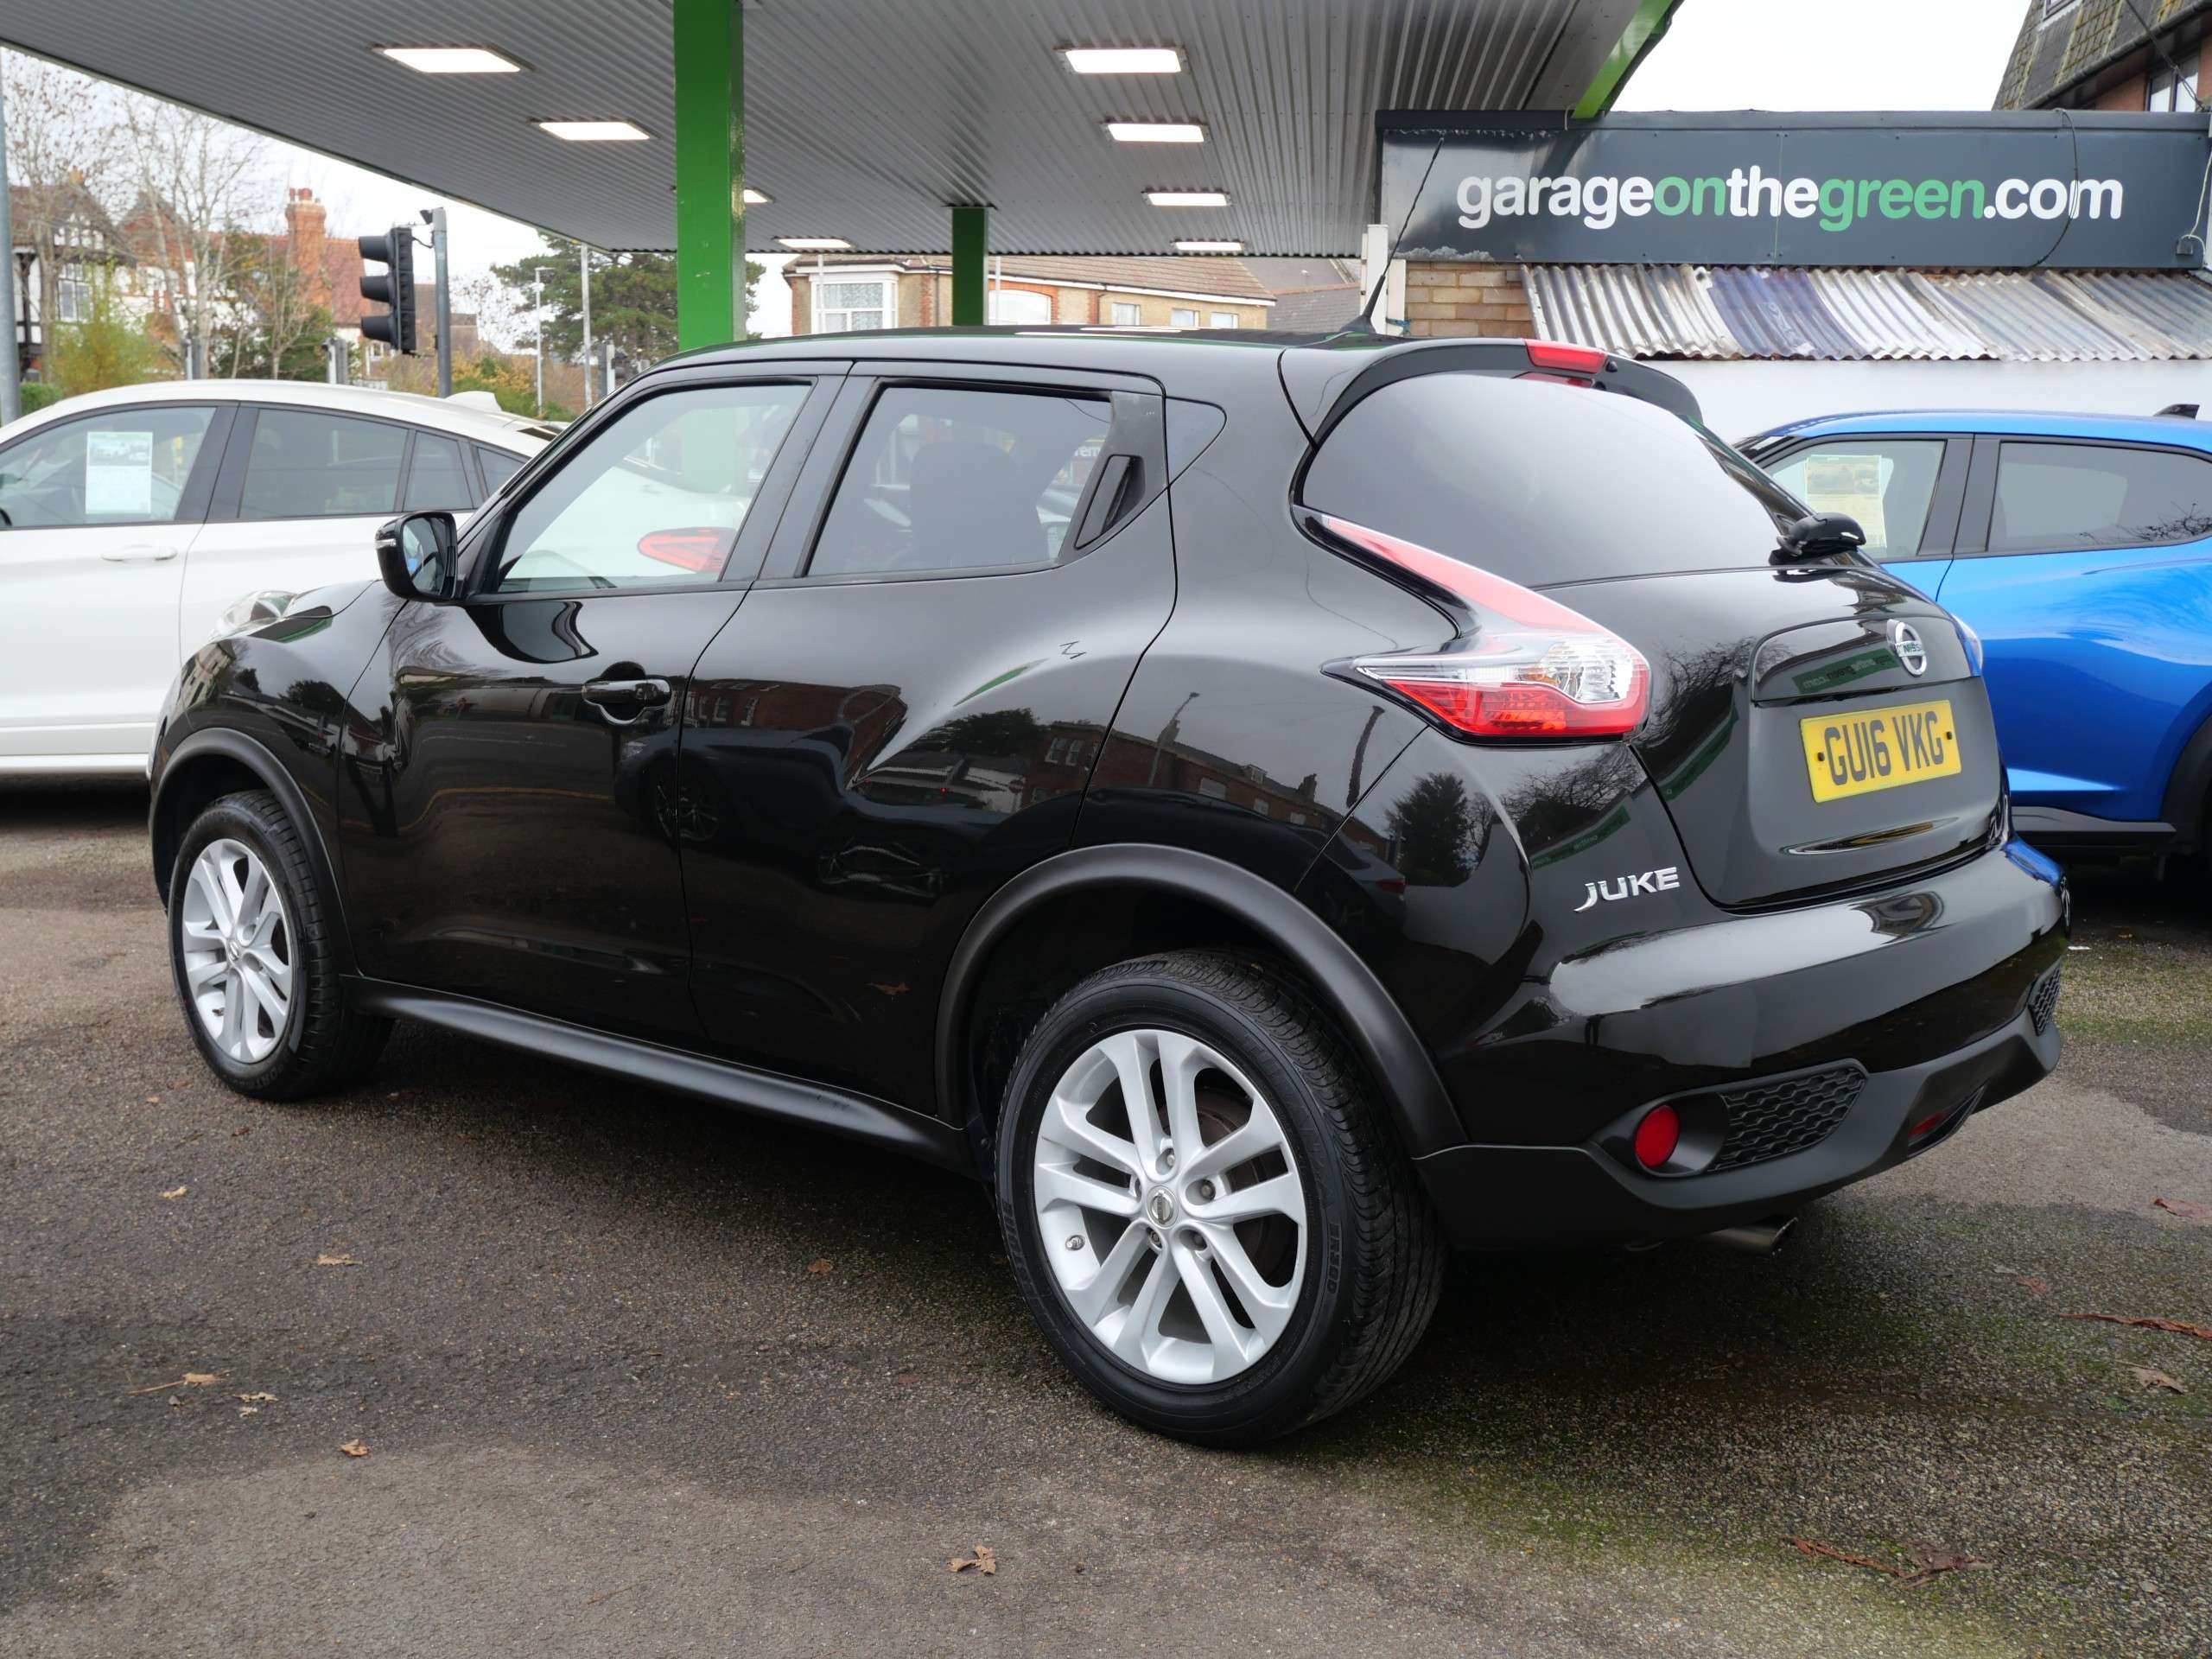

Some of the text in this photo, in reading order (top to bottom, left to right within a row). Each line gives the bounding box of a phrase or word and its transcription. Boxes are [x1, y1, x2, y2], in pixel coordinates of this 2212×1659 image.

[1456, 165, 2123, 232] garageonthegreen.com
[1824, 710, 1945, 786] GU16 VKG
[1573, 866, 1681, 912] JUKE
